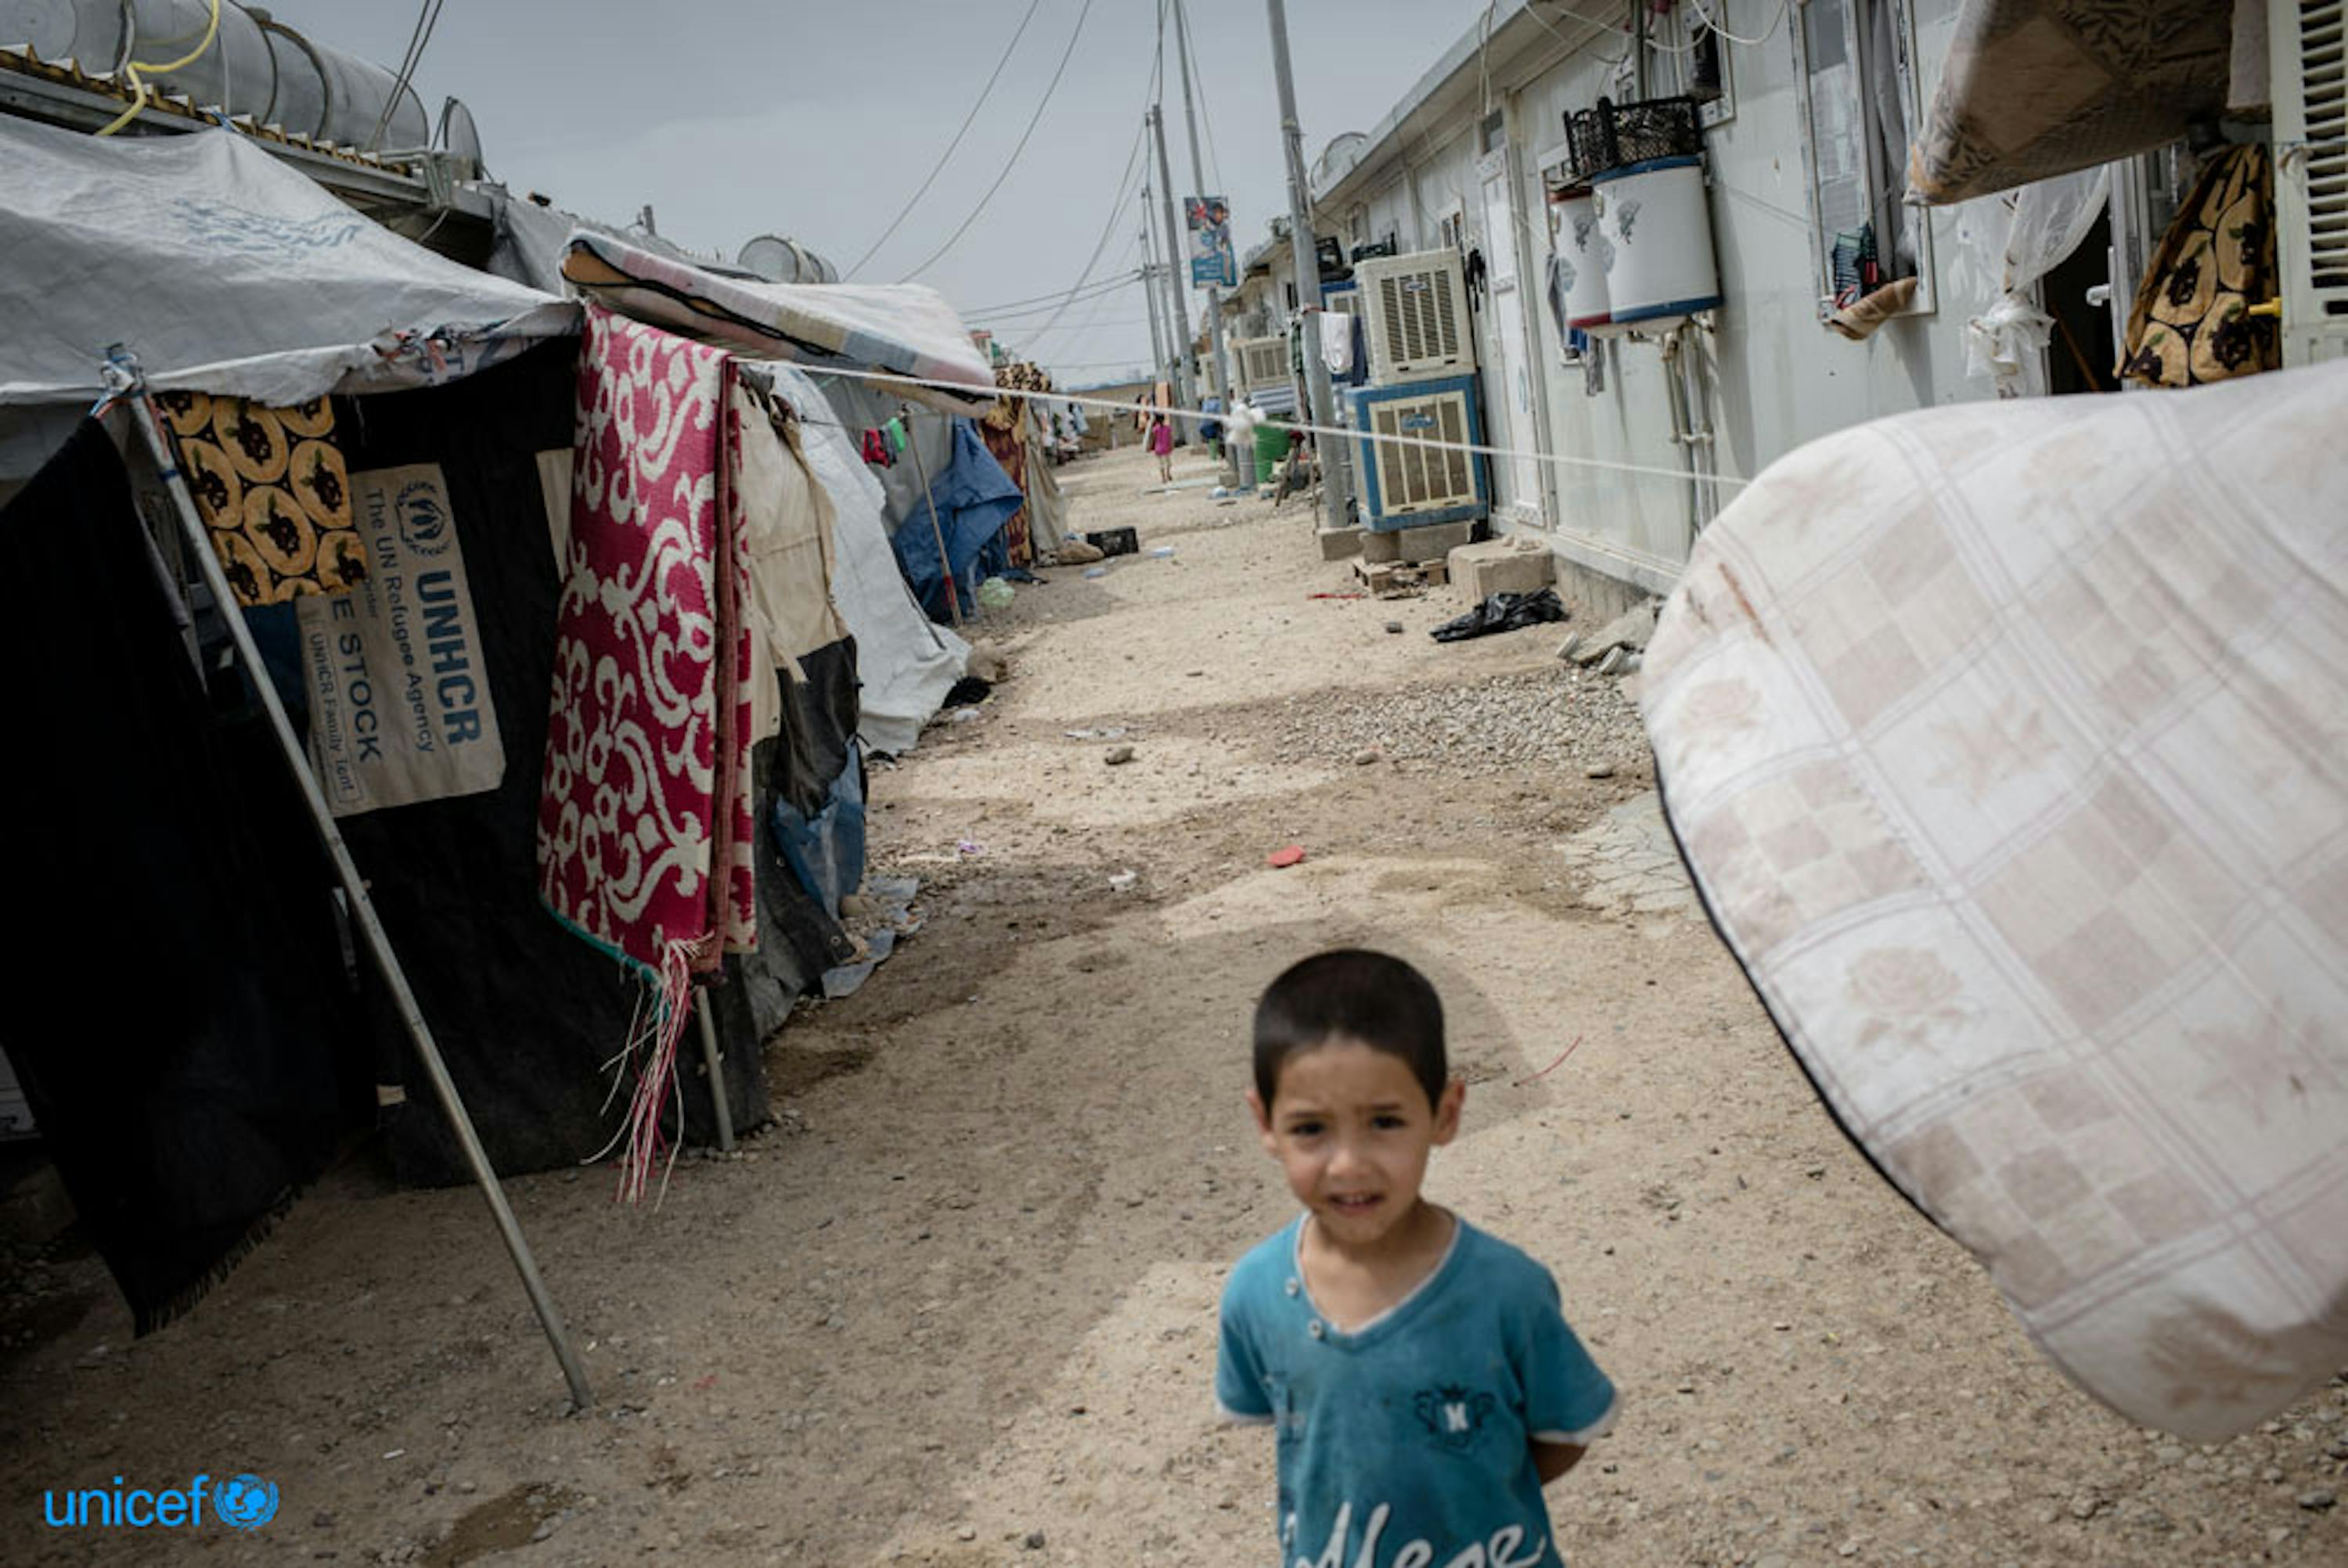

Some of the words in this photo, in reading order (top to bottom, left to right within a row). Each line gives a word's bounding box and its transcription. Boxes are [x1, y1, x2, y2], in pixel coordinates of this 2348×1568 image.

[367, 488, 385, 529] The
[376, 536, 398, 568] UN
[385, 575, 414, 665] Refugee
[416, 570, 481, 746] UNHCR
[311, 633, 333, 695] UNHCR
[325, 699, 342, 752] Family
[339, 634, 382, 763] STOCK
[406, 673, 434, 752] Agency
